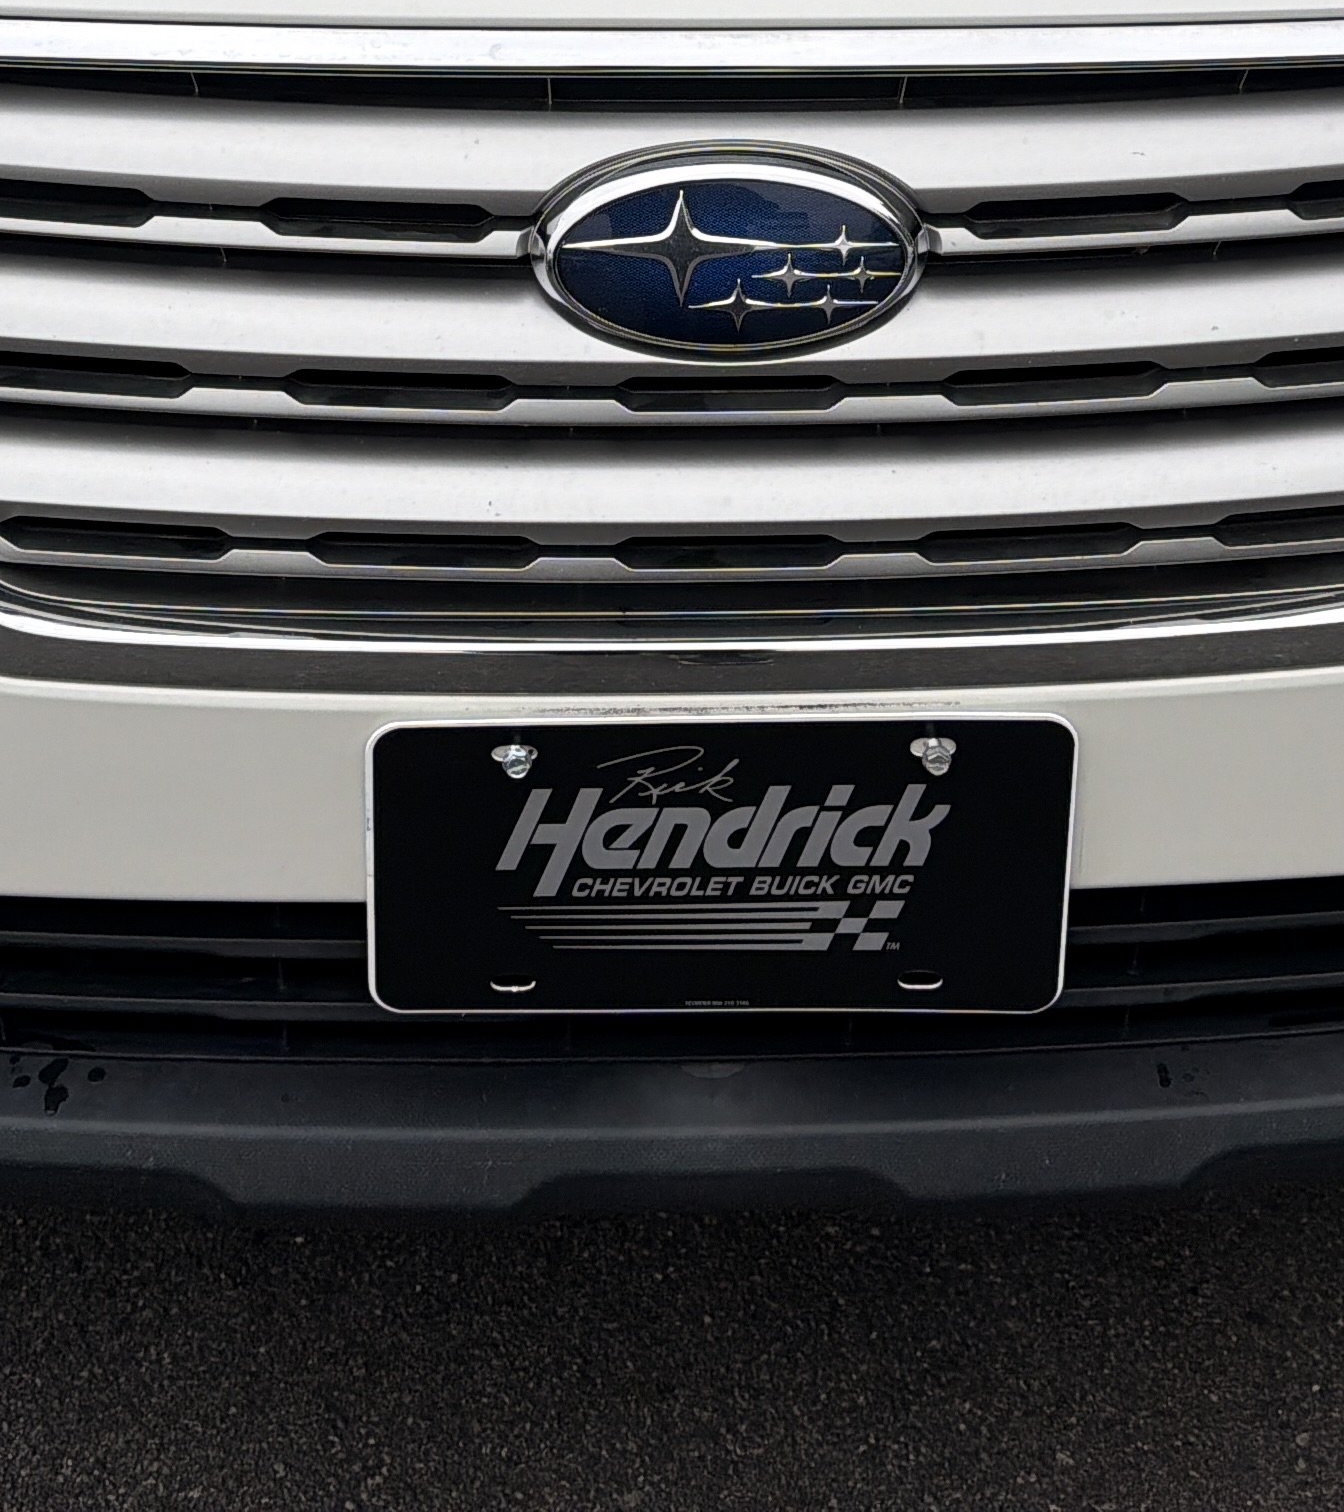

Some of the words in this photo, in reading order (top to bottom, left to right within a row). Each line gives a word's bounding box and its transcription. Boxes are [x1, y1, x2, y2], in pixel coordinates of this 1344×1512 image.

[495, 783, 952, 897] Hendrick
[571, 875, 745, 898] CHEVROLET
[748, 874, 841, 896] BUICK
[846, 873, 916, 895] GMC
